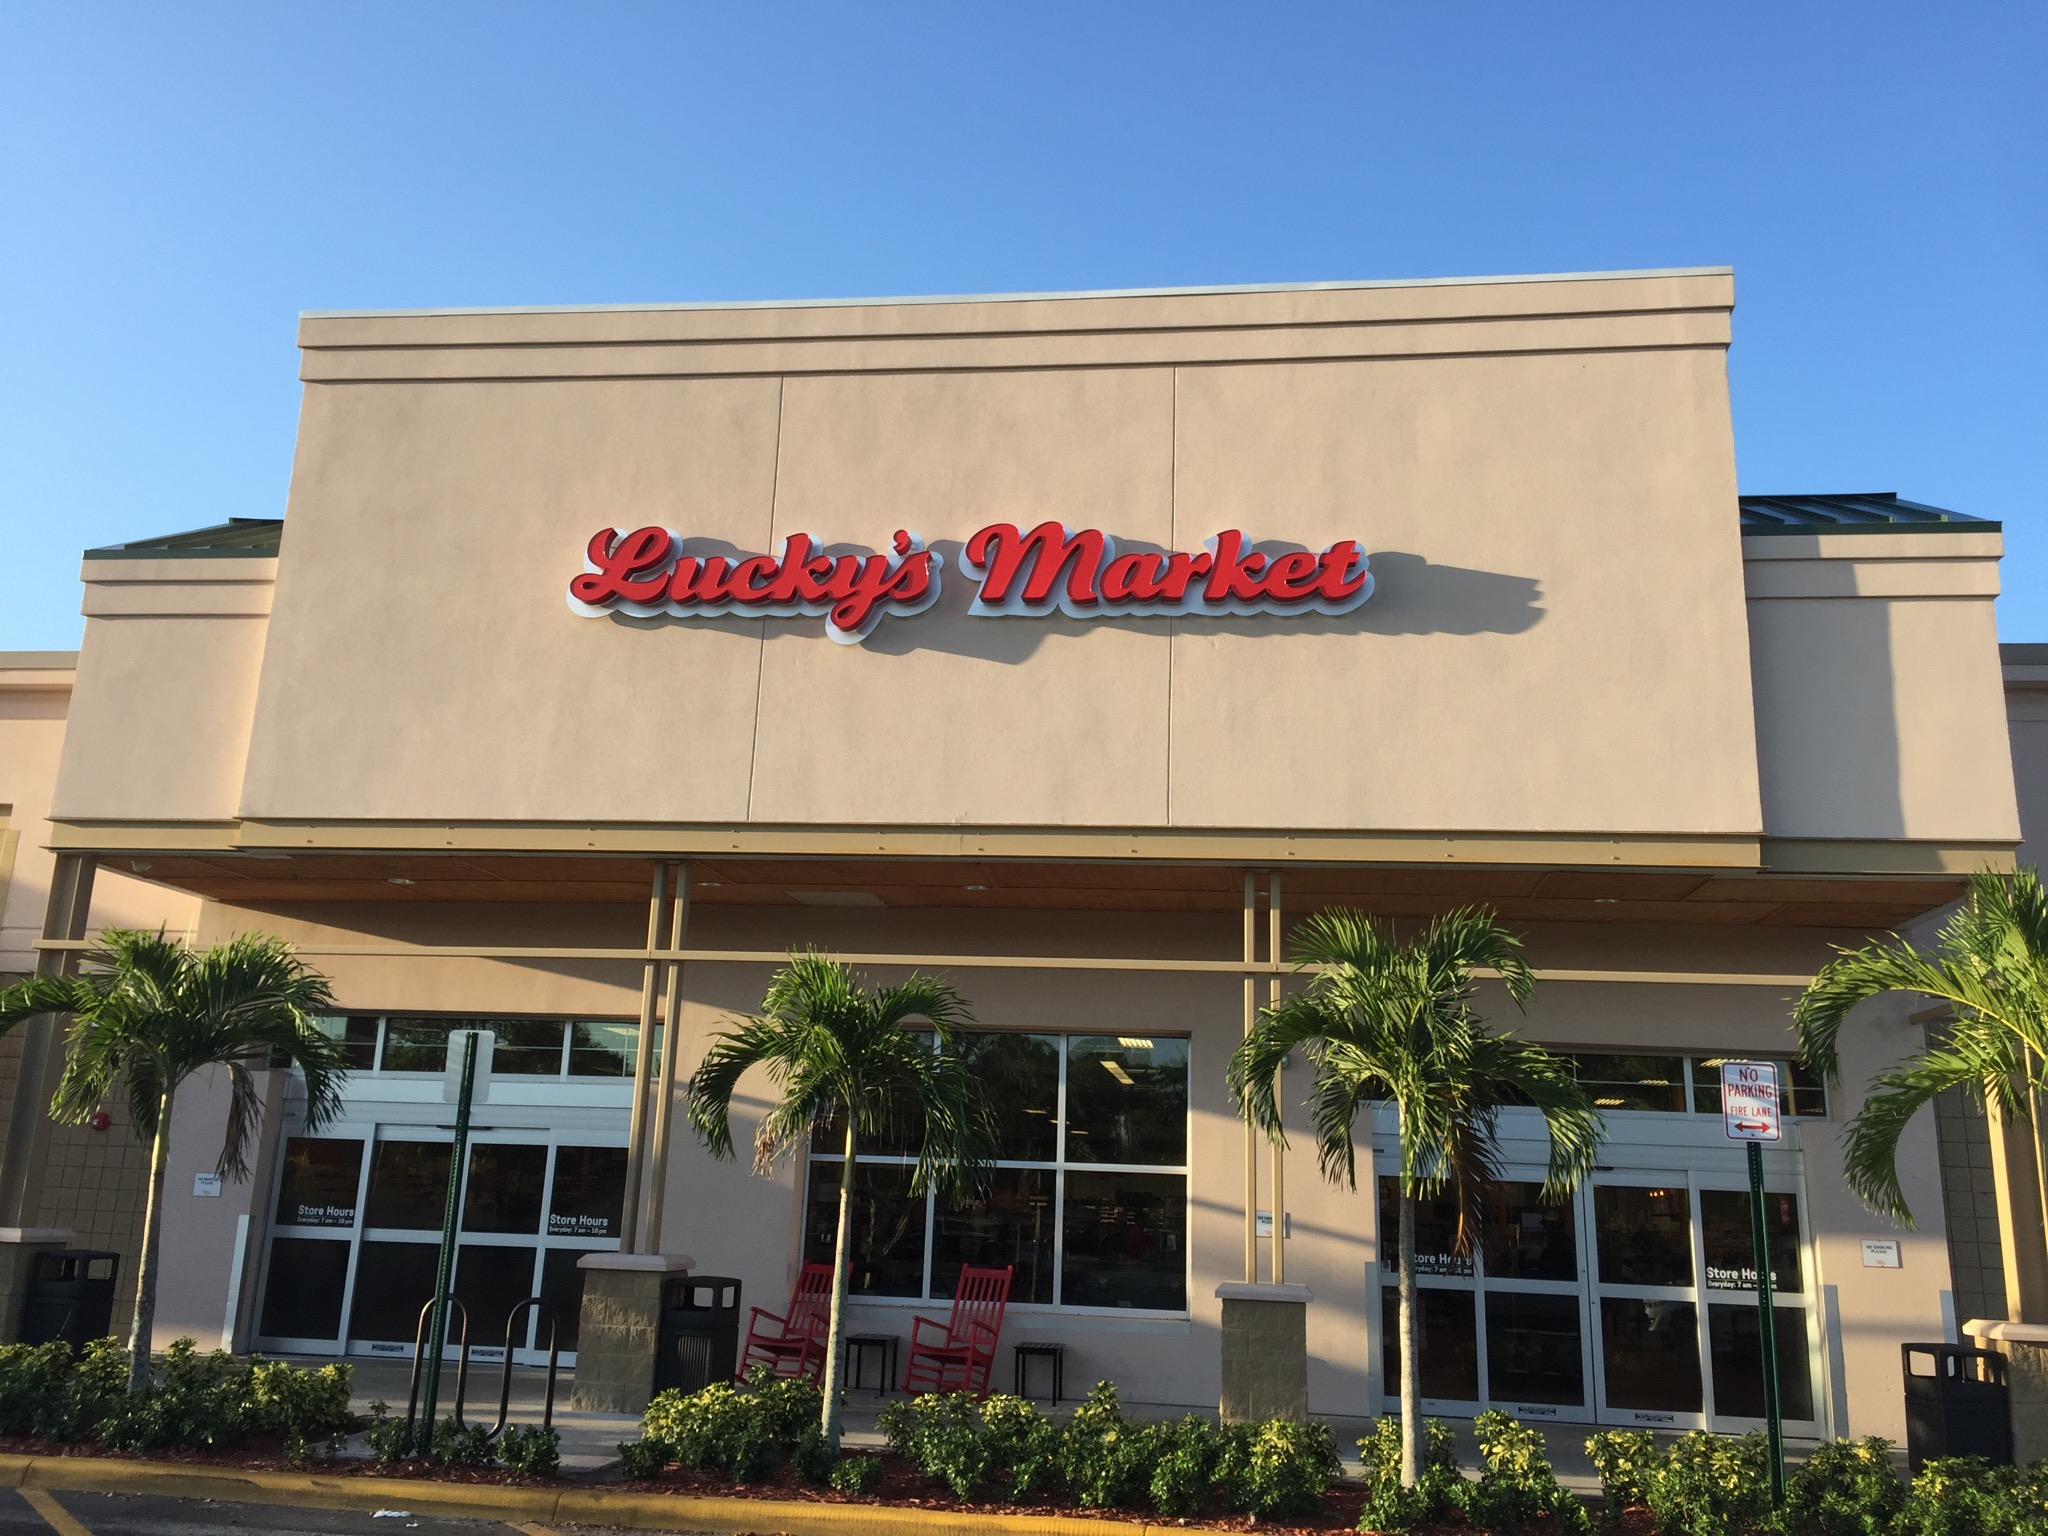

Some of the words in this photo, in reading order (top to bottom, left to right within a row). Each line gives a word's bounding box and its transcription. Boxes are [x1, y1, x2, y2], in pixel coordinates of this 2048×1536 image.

[569, 526, 932, 632] Lucky's
[965, 520, 1367, 604] Market
[1739, 1068, 1758, 1082] NO
[1728, 1083, 1773, 1098] PARKING
[1730, 1106, 1748, 1116] FIRE
[1752, 1107, 1773, 1117] LANE
[298, 1204, 325, 1216] Store
[326, 1205, 355, 1217] Hours
[549, 1213, 577, 1225] Store
[579, 1215, 609, 1227] Hours
[1414, 1252, 1436, 1264] tore
[1706, 1266, 1739, 1279] Store
[1741, 1267, 1777, 1281] Hos
